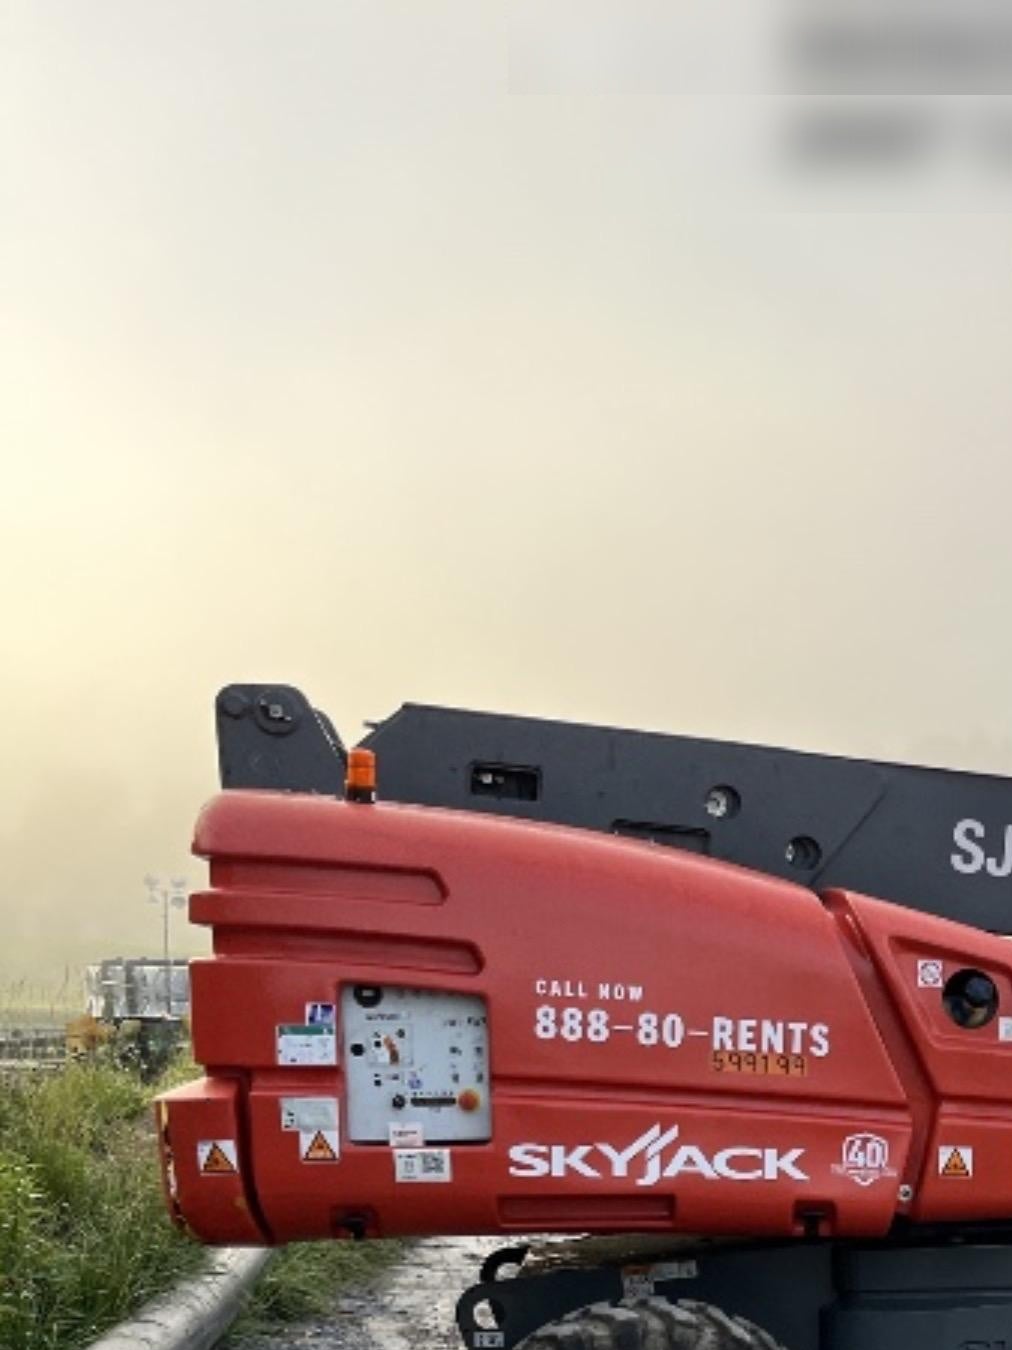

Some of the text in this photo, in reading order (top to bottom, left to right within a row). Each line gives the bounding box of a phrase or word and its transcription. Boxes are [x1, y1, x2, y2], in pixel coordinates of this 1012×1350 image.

[535, 979, 644, 1001] CALL NOW
[535, 1004, 830, 1058] 888-80-RENTS
[508, 1121, 809, 1186] SKYJACK
